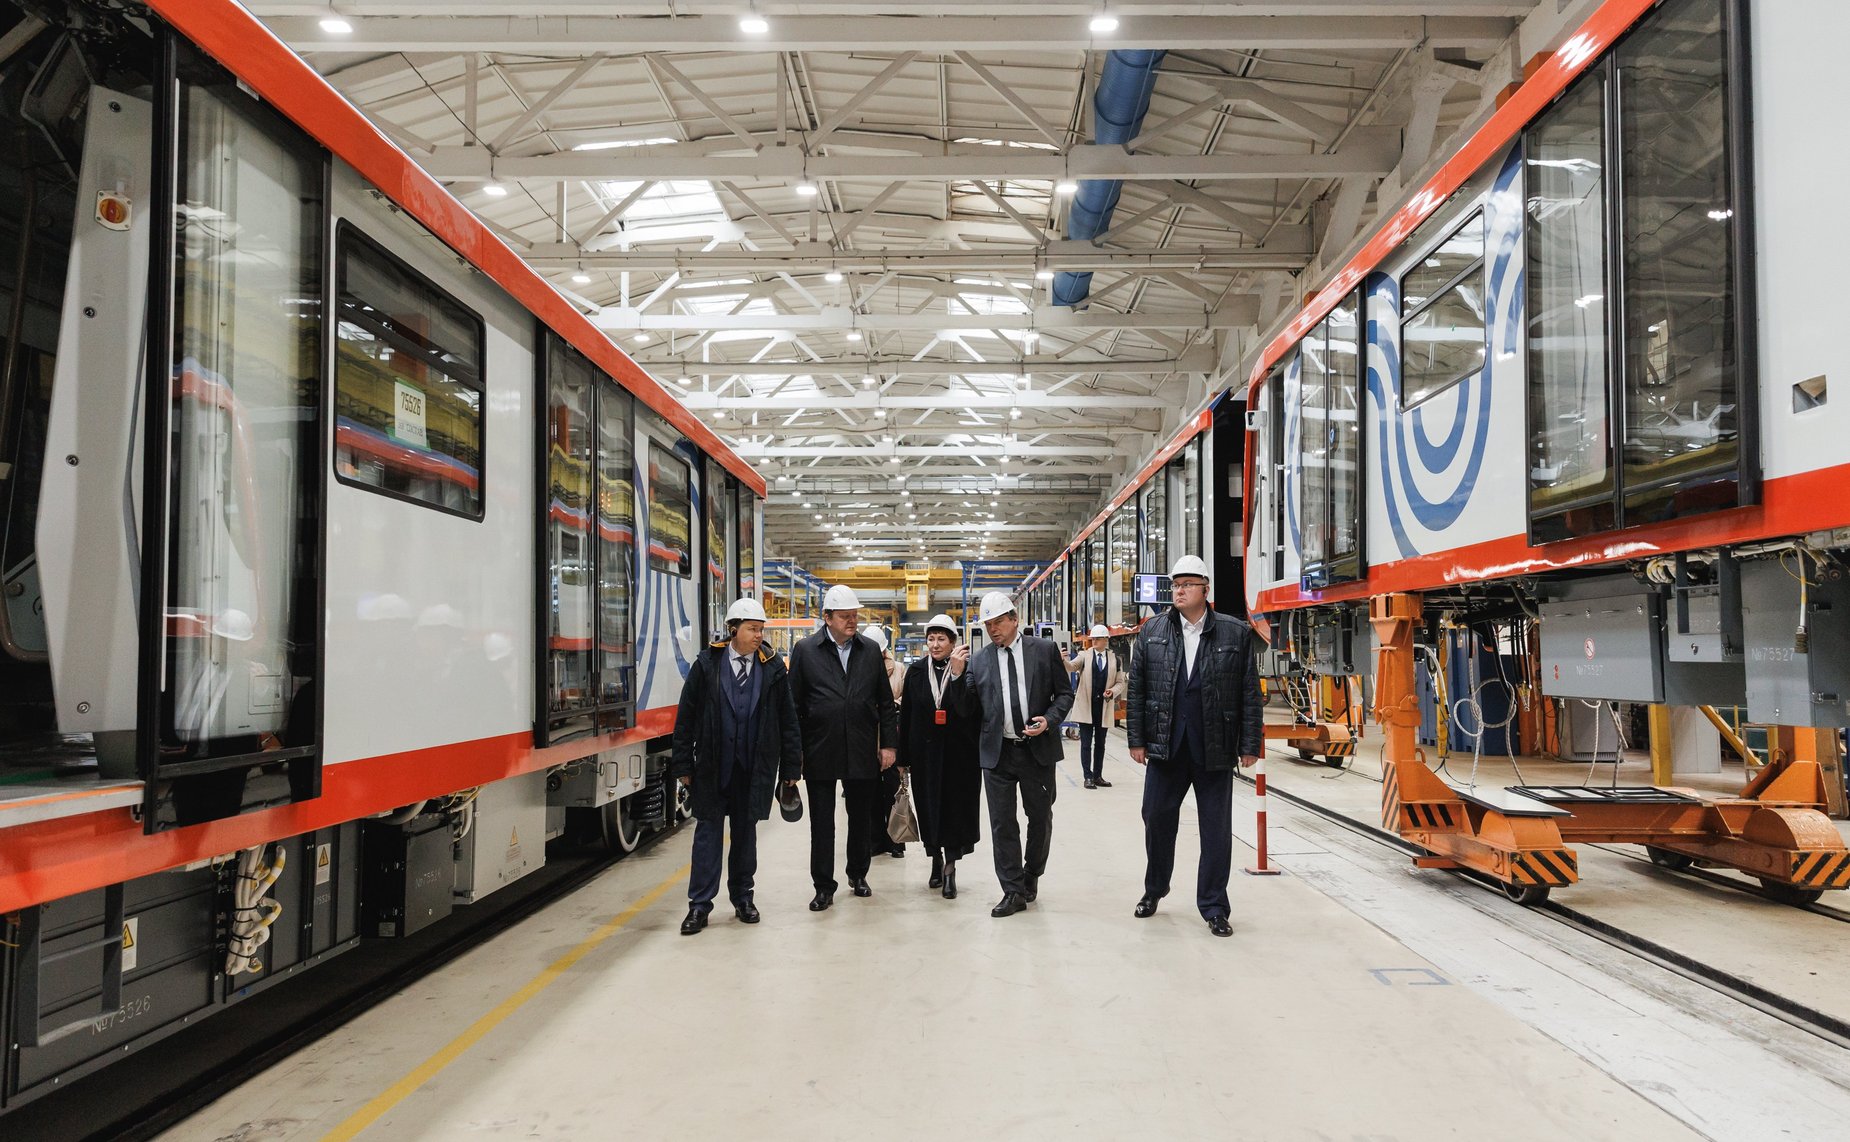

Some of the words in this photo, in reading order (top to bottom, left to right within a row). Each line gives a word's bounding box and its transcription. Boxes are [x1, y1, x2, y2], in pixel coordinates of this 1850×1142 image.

[401, 391, 421, 416] 75526
[1143, 582, 1154, 598] 5
[1751, 647, 1795, 662] №75527
